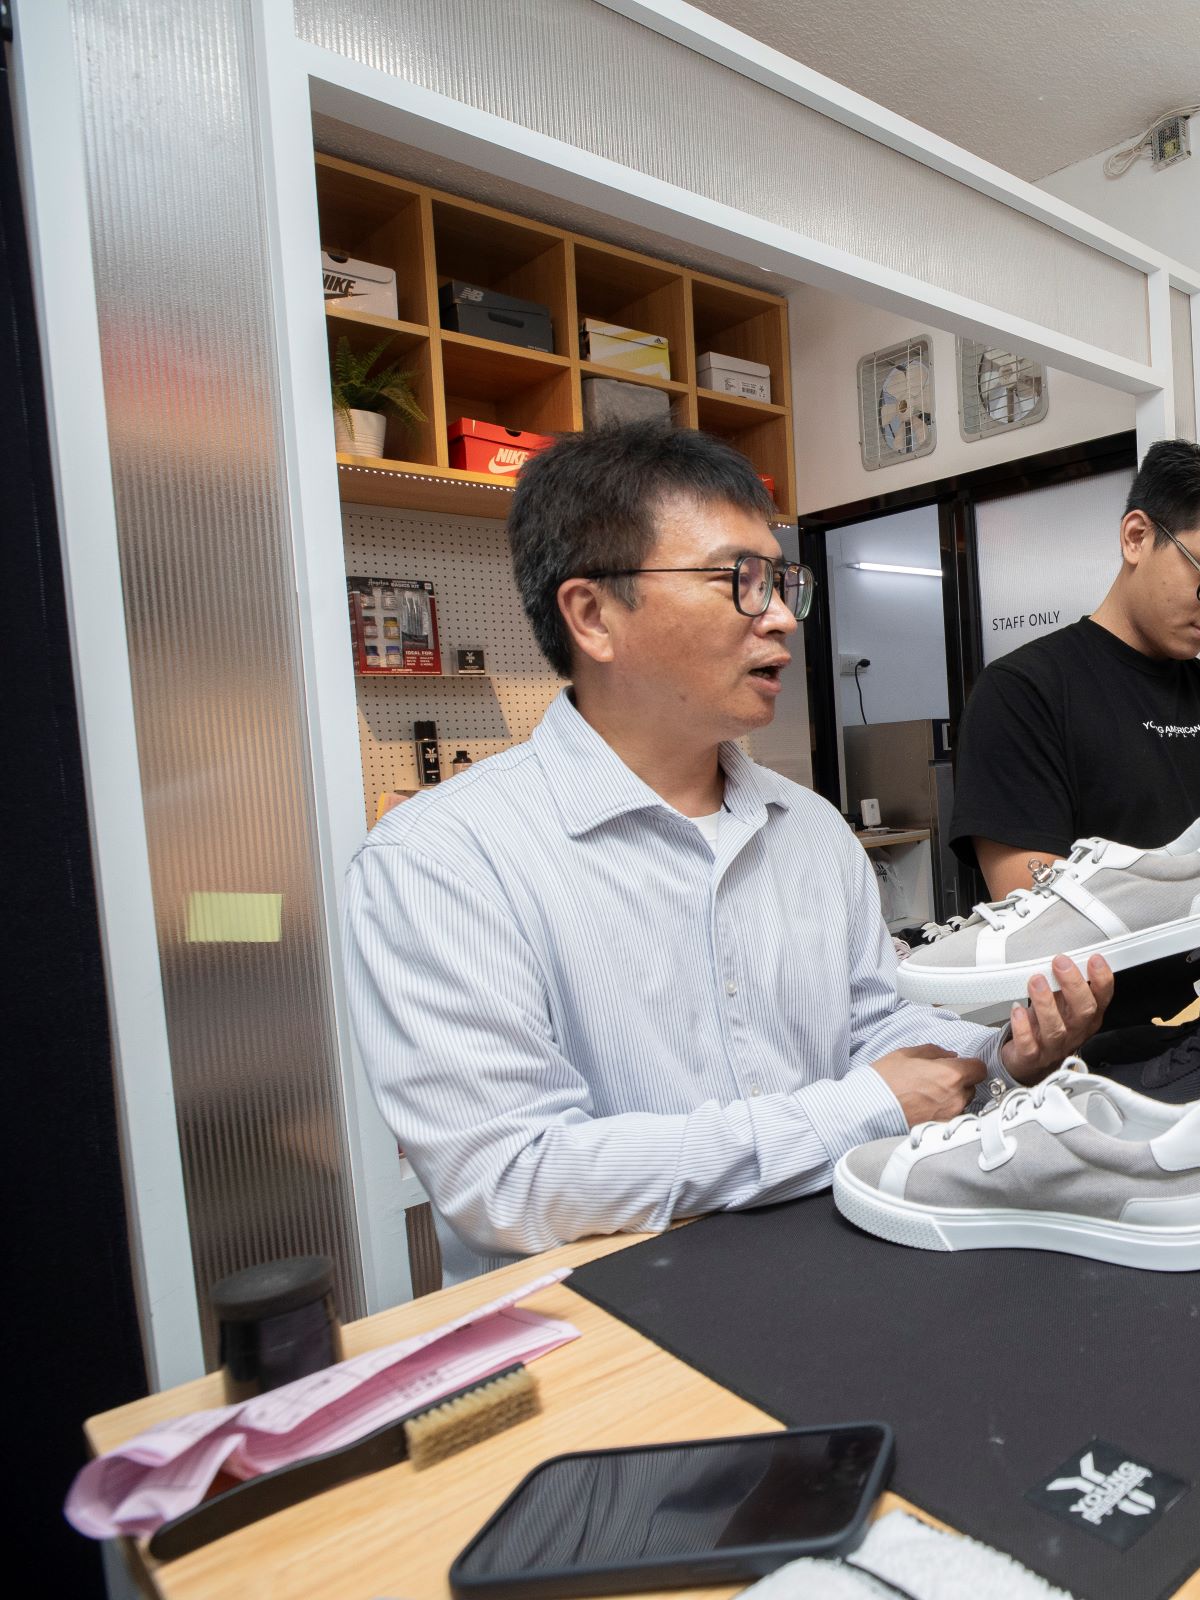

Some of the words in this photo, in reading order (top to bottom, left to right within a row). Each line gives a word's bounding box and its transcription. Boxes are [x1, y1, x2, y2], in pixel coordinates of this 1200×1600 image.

[495, 447, 529, 465] NIKE
[992, 615, 1025, 631] STAFF
[1028, 610, 1060, 627] ONLY
